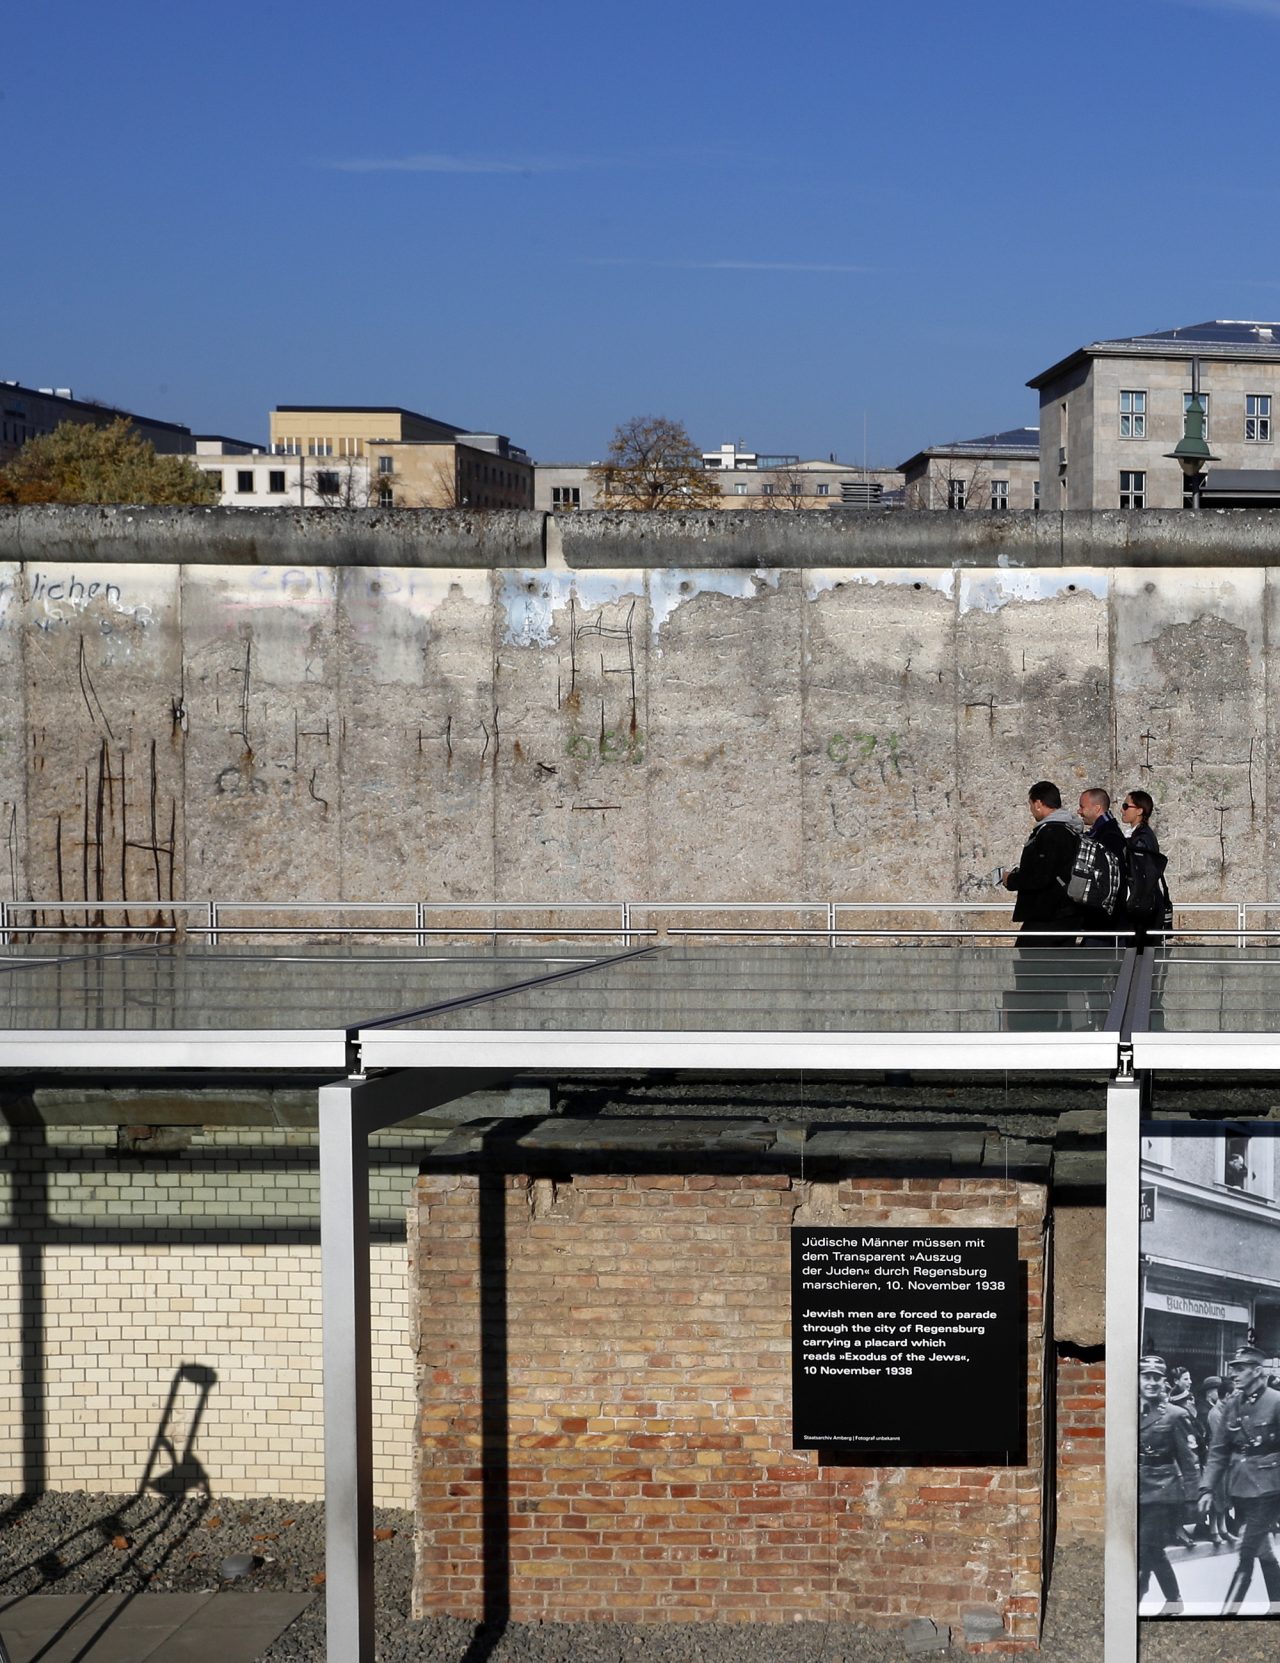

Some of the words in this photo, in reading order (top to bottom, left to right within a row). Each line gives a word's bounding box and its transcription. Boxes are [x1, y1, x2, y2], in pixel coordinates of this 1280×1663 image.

[801, 1236, 858, 1248] Jüdische
[861, 1237, 910, 1248] Männer
[912, 1237, 962, 1248] müssen
[964, 1237, 986, 1248] mit
[801, 1251, 829, 1262] dem
[831, 1251, 906, 1264] Transparent
[801, 1265, 823, 1276] der
[873, 1266, 910, 1276] durch
[913, 1266, 988, 1279] Regensburg
[802, 1280, 881, 1291] marschieren,
[885, 1280, 904, 1291] 10.
[907, 1280, 972, 1291] November
[975, 1280, 1006, 1291] 1938
[1166, 1295, 1226, 1319] Buchhandlung
[802, 1308, 845, 1319] Jewish
[847, 1311, 874, 1319] men
[876, 1311, 897, 1319] are
[899, 1309, 938, 1319] forced
[940, 1310, 954, 1319] to
[955, 1310, 998, 1321] parade
[802, 1323, 849, 1335] through
[851, 1323, 872, 1333] the
[873, 1323, 897, 1335] city
[898, 1323, 913, 1333] of
[914, 1323, 986, 1335] Regensburg
[802, 1337, 851, 1349] carrying
[853, 1339, 862, 1347] a
[864, 1337, 908, 1349] placard
[910, 1338, 947, 1348] which
[802, 1351, 837, 1361] reads
[889, 1352, 904, 1362] of
[905, 1352, 926, 1362] the
[803, 1365, 818, 1375] 10
[820, 1365, 882, 1376] November
[885, 1366, 913, 1376] 1938
